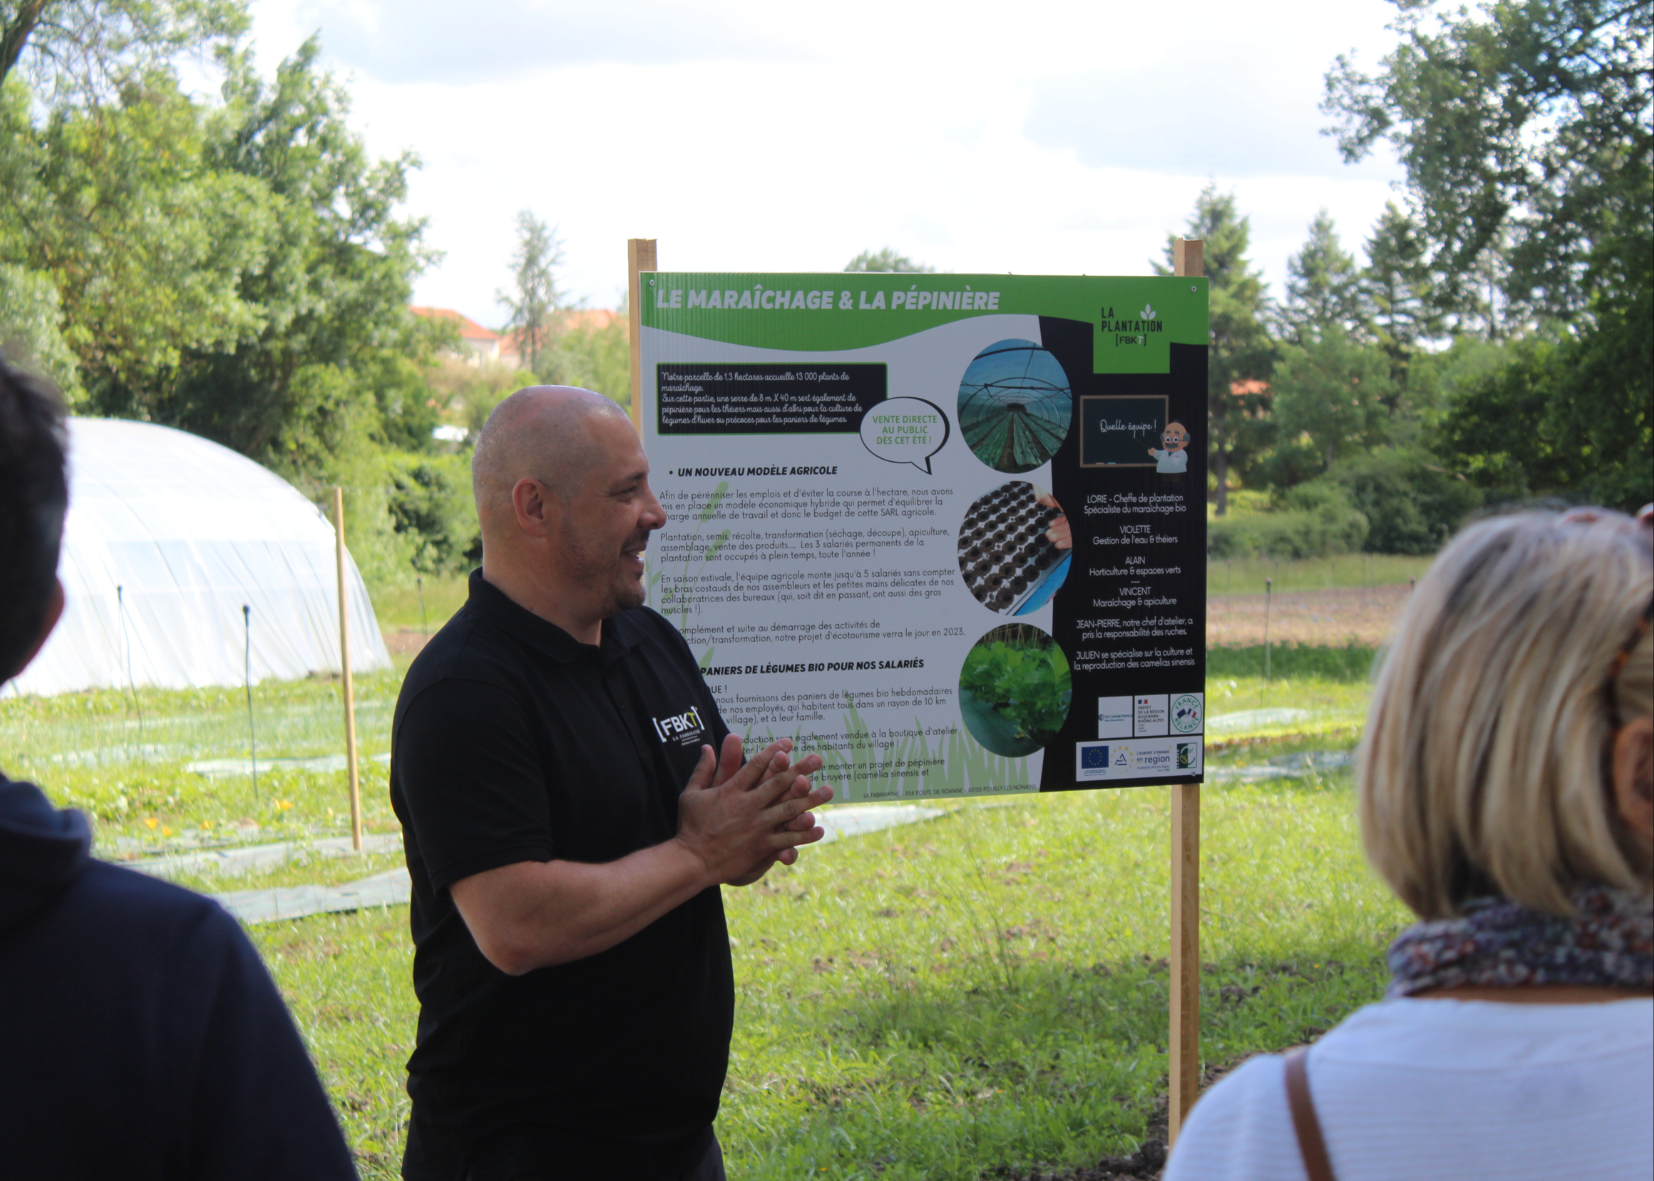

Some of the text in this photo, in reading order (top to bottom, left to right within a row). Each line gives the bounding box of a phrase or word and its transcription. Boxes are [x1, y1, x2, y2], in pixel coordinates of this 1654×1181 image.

[657, 284, 1000, 310] LE MARAÎCHAGE & LA PÉPINIÈRE
[1102, 307, 1114, 318] LA
[1102, 321, 1162, 332] PLANTATION
[662, 372, 684, 381] Notre
[684, 372, 713, 383] parcelle
[714, 372, 724, 380] de
[734, 372, 764, 380] hectares
[765, 372, 795, 380] accueille
[796, 372, 802, 380] 13
[804, 372, 817, 380] 000
[818, 372, 839, 383] plants
[840, 372, 850, 380] de
[662, 415, 690, 427] légumes
[692, 415, 715, 423] d'hiver
[726, 416, 754, 426] précoces
[756, 417, 771, 426] pour
[772, 414, 782, 423] les
[784, 417, 808, 426] paniers
[810, 414, 818, 423] de
[902, 415, 937, 423] DIRECTE
[882, 426, 894, 434] AU
[1100, 419, 1126, 432] Quelle
[1128, 422, 1152, 438] équipe
[876, 435, 892, 444] DÈS
[895, 436, 910, 444] CET
[912, 434, 926, 444] ÉTÉ
[678, 464, 838, 476] UN NOUVEAU MODÈLE AGRICOLE
[660, 490, 675, 500] Afin
[678, 490, 688, 499] de
[736, 489, 747, 499] les
[750, 489, 780, 500] emplois
[783, 490, 791, 498] et
[794, 488, 824, 497] d'éviter
[826, 488, 834, 497] la
[865, 488, 870, 497] à
[872, 487, 909, 497] l'hectare,
[1087, 494, 1107, 504] LORIE
[1114, 493, 1137, 503] Cheffe
[1138, 493, 1147, 503] de
[1149, 492, 1183, 504] plantation
[688, 500, 712, 512] place
[726, 500, 756, 509] modèle
[758, 500, 808, 510] économique
[810, 498, 840, 509] hybride
[843, 499, 854, 509] qui
[857, 499, 885, 509] permet
[888, 497, 933, 508] d'équilibrer
[935, 497, 943, 506] la
[1084, 504, 1121, 516] Spécialiste
[1122, 504, 1131, 513] du
[1175, 503, 1186, 512] bio
[765, 529, 823, 539] transformation
[825, 528, 864, 539] (séchage,
[867, 527, 906, 539] découpe),
[909, 527, 950, 537] apiculture,
[1120, 525, 1151, 534] VIOLETTE
[1093, 534, 1178, 545] Gestion de l'eau & théiers
[1125, 556, 1145, 565] ALAIN
[661, 575, 671, 583] En
[673, 575, 698, 583] saison
[700, 572, 733, 582] estivale,
[736, 572, 769, 583] l'équipe
[771, 570, 804, 582] agricole
[834, 570, 862, 581] jusqu'à
[864, 570, 869, 578] 5
[871, 568, 902, 578] salariés
[922, 569, 955, 578] compter
[1089, 566, 1181, 577] Horticulture & espaces verts
[1119, 587, 1151, 596] VINCENT
[1138, 598, 1142, 606] &
[1144, 596, 1177, 608] apiculture
[662, 604, 692, 614] muscles
[1123, 619, 1140, 627] notre
[1141, 616, 1157, 626] chef
[799, 632, 822, 643] projet
[825, 630, 880, 640] d'écotourisme
[905, 628, 912, 637] le
[914, 630, 929, 639] jour
[700, 657, 924, 676] PANIERS DE LÉGUMES BIO POUR NOS SALARIÉS
[736, 694, 779, 704] fournissons
[781, 692, 795, 701] des
[798, 693, 826, 703] paniers
[829, 690, 840, 699] de
[842, 690, 874, 701] légumes
[876, 688, 889, 698] bio
[891, 686, 952, 697] hebdomadaires
[1175, 698, 1199, 710] FRANCE
[1175, 717, 1199, 730] RELANCE
